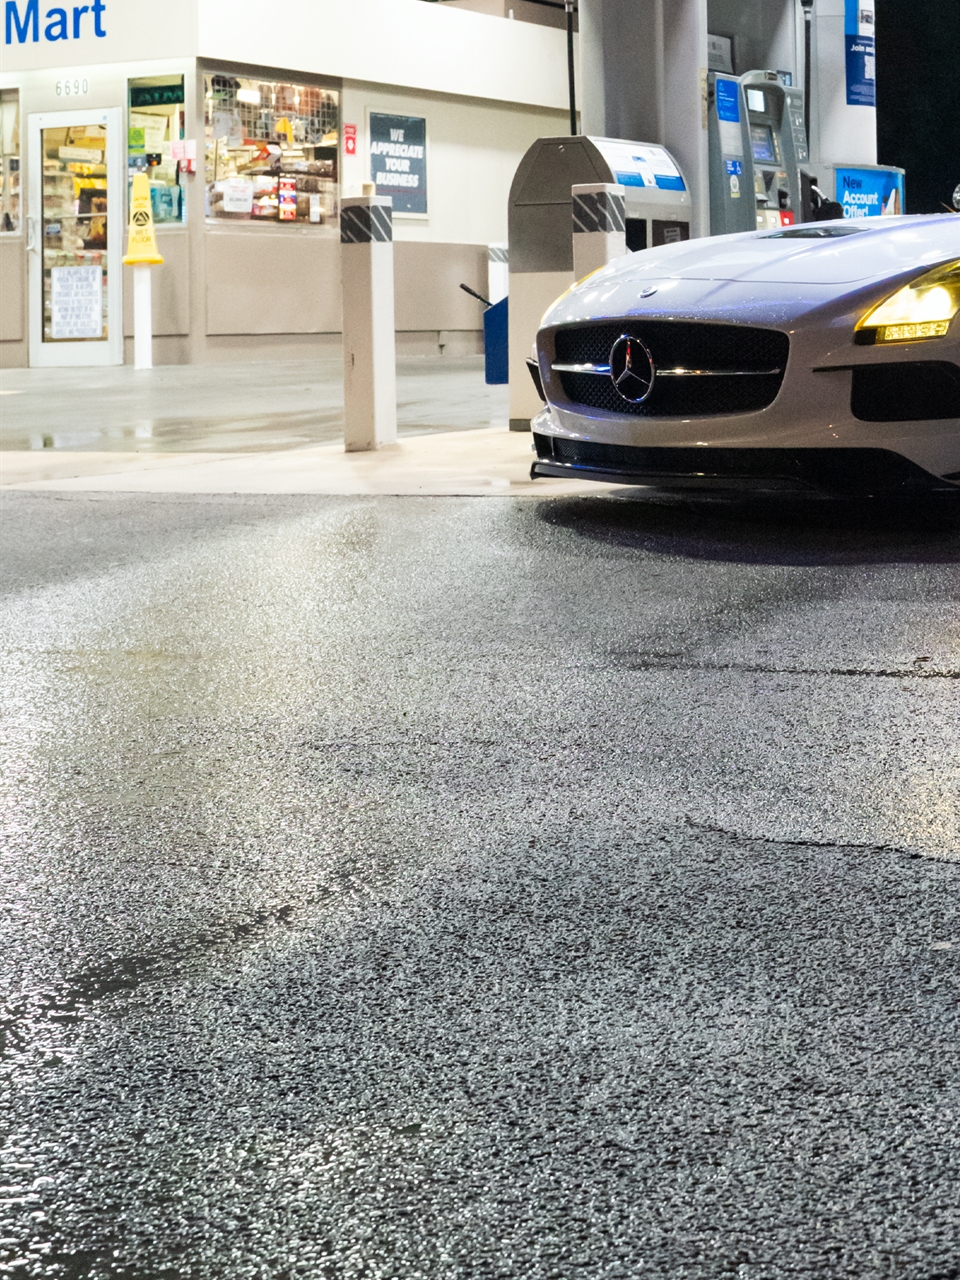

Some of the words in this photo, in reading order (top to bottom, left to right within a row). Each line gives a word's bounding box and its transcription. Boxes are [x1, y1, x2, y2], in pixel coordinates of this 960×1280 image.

[55, 78, 89, 96] 6690
[390, 128, 405, 142] WE
[370, 141, 424, 158] APPRECIATE
[385, 157, 411, 172] YOUR
[376, 172, 419, 188] BUSINESS
[843, 175, 862, 189] New
[843, 190, 878, 205] Account
[843, 205, 868, 218] Offer!
